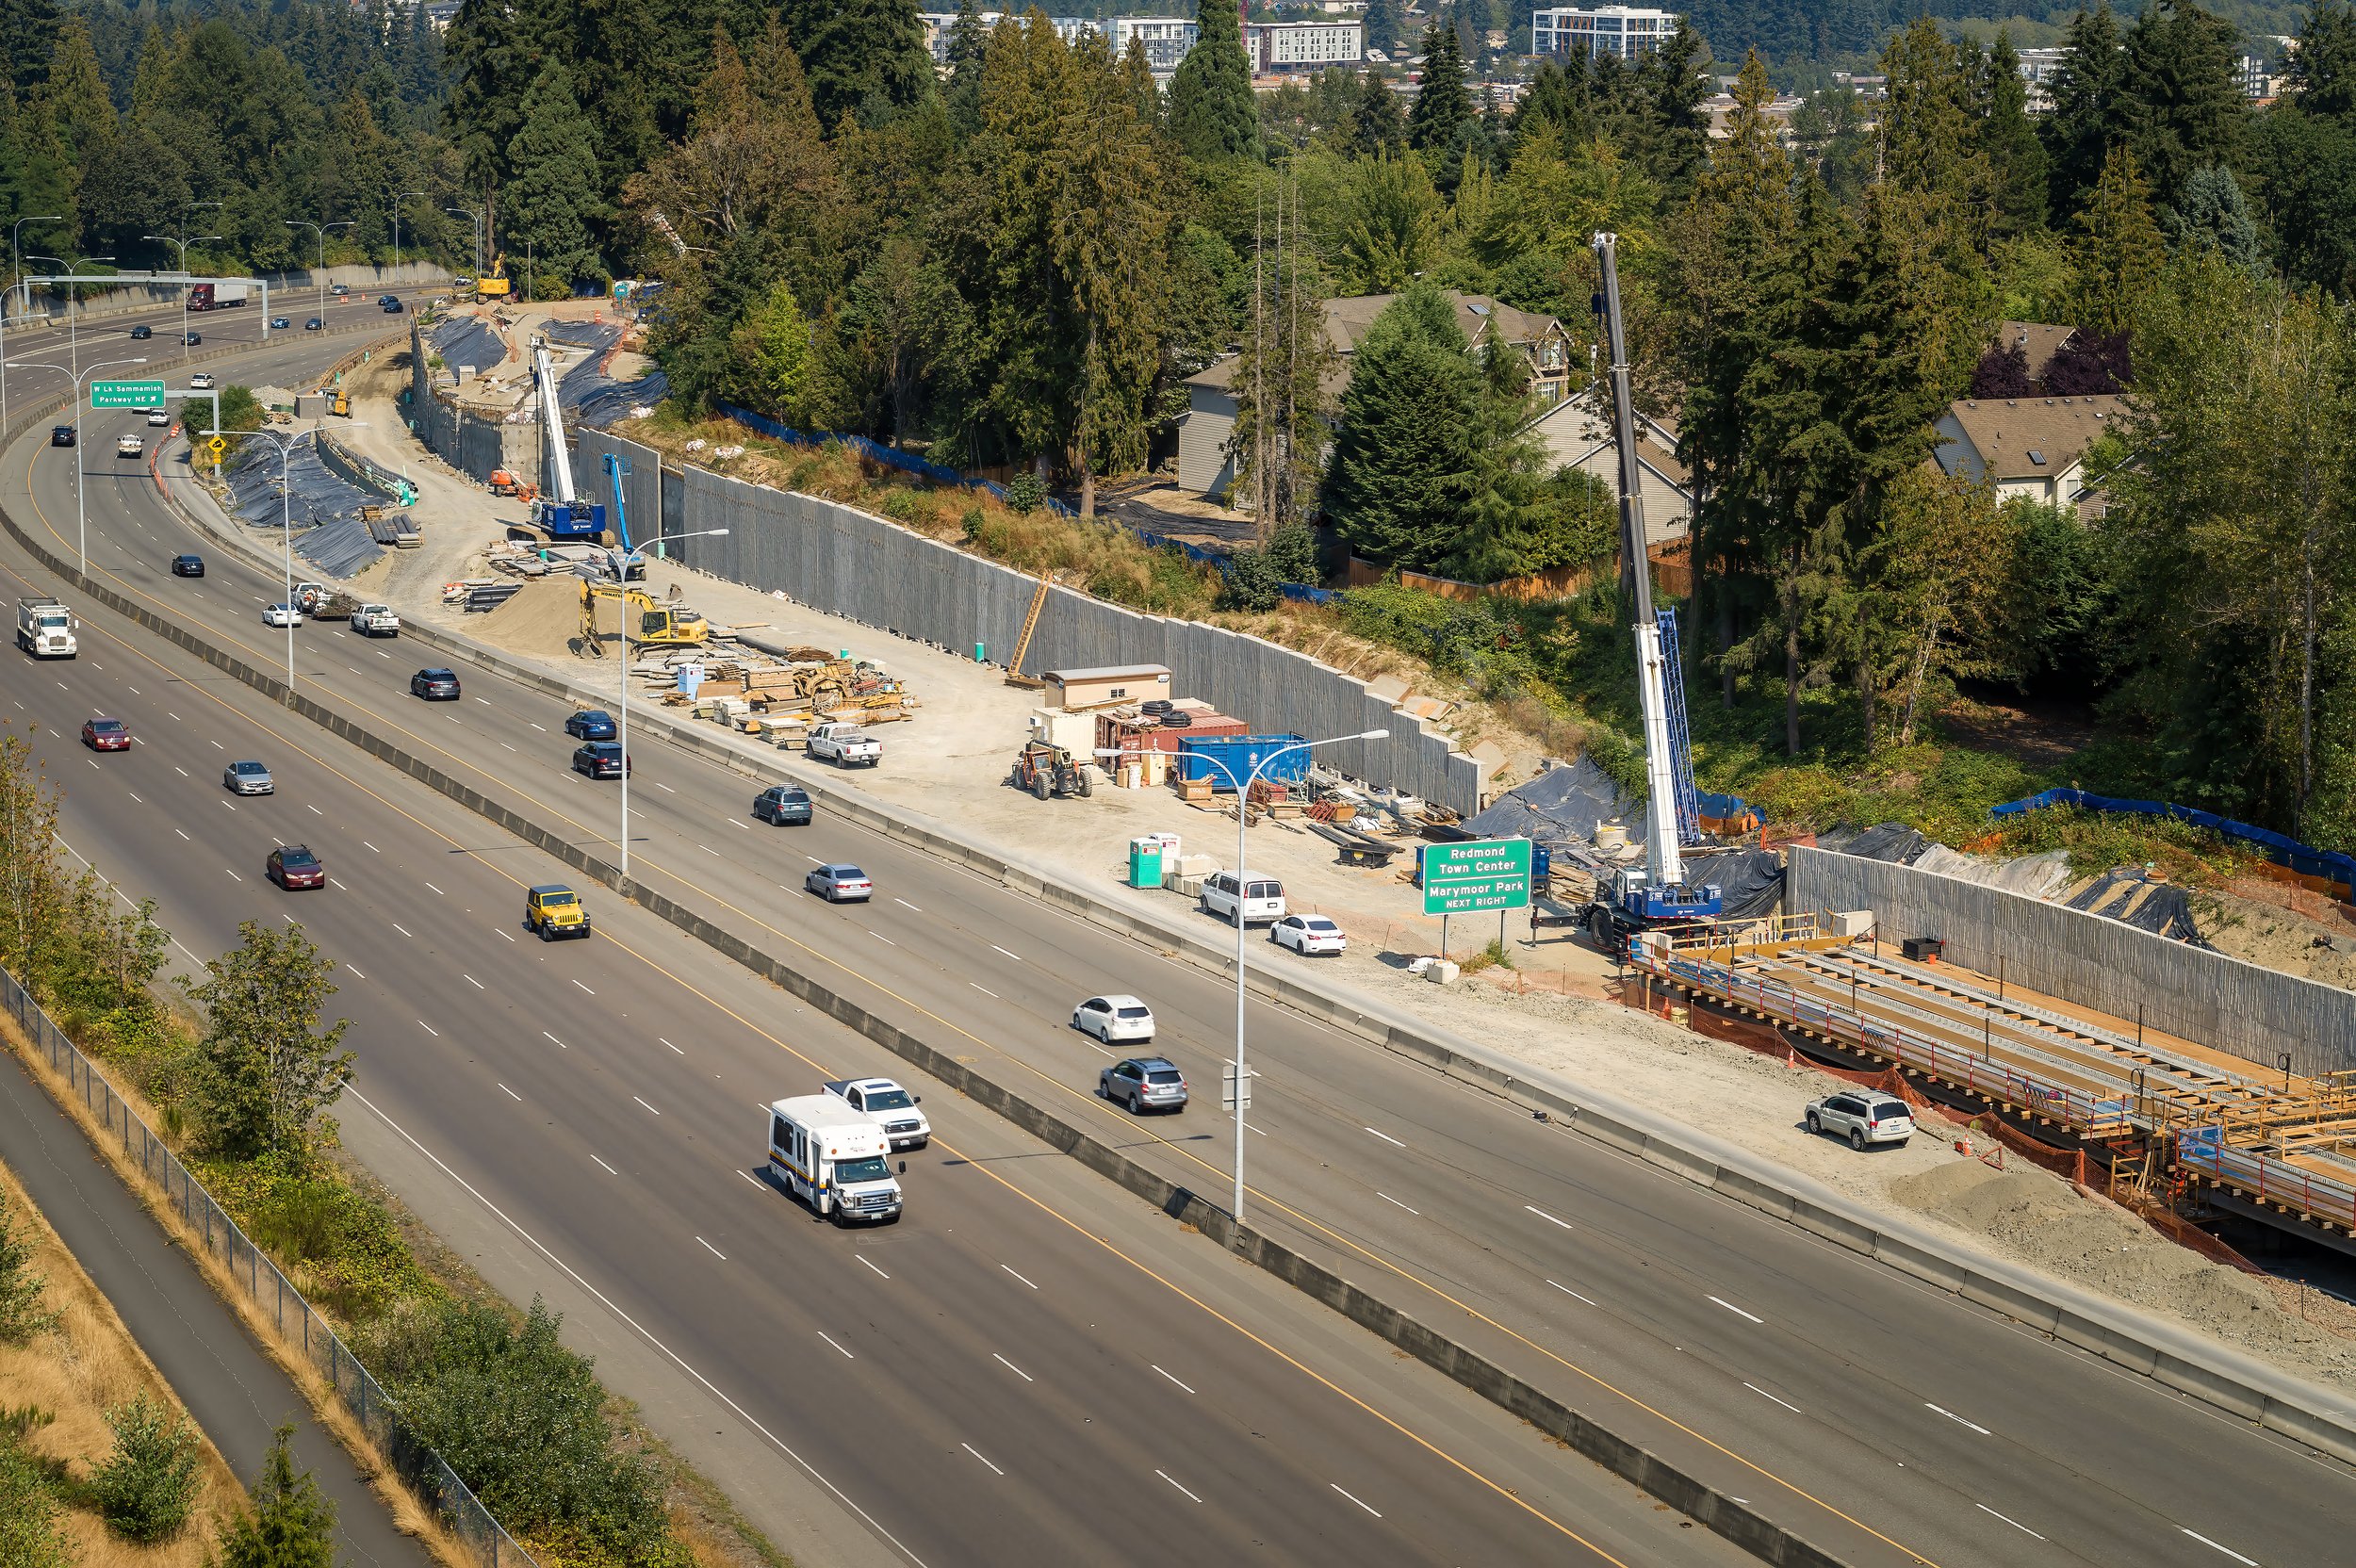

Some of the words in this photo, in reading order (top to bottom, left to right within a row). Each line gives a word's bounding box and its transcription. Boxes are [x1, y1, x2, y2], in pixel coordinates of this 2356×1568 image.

[1450, 846, 1506, 859] Redmond
[1439, 864, 1469, 874] Town
[1475, 860, 1516, 872] Center
[1430, 884, 1491, 897] Marymoor
[1496, 880, 1524, 892] Park
[1446, 899, 1471, 908] NEXT
[1476, 896, 1507, 906] RIGHT
